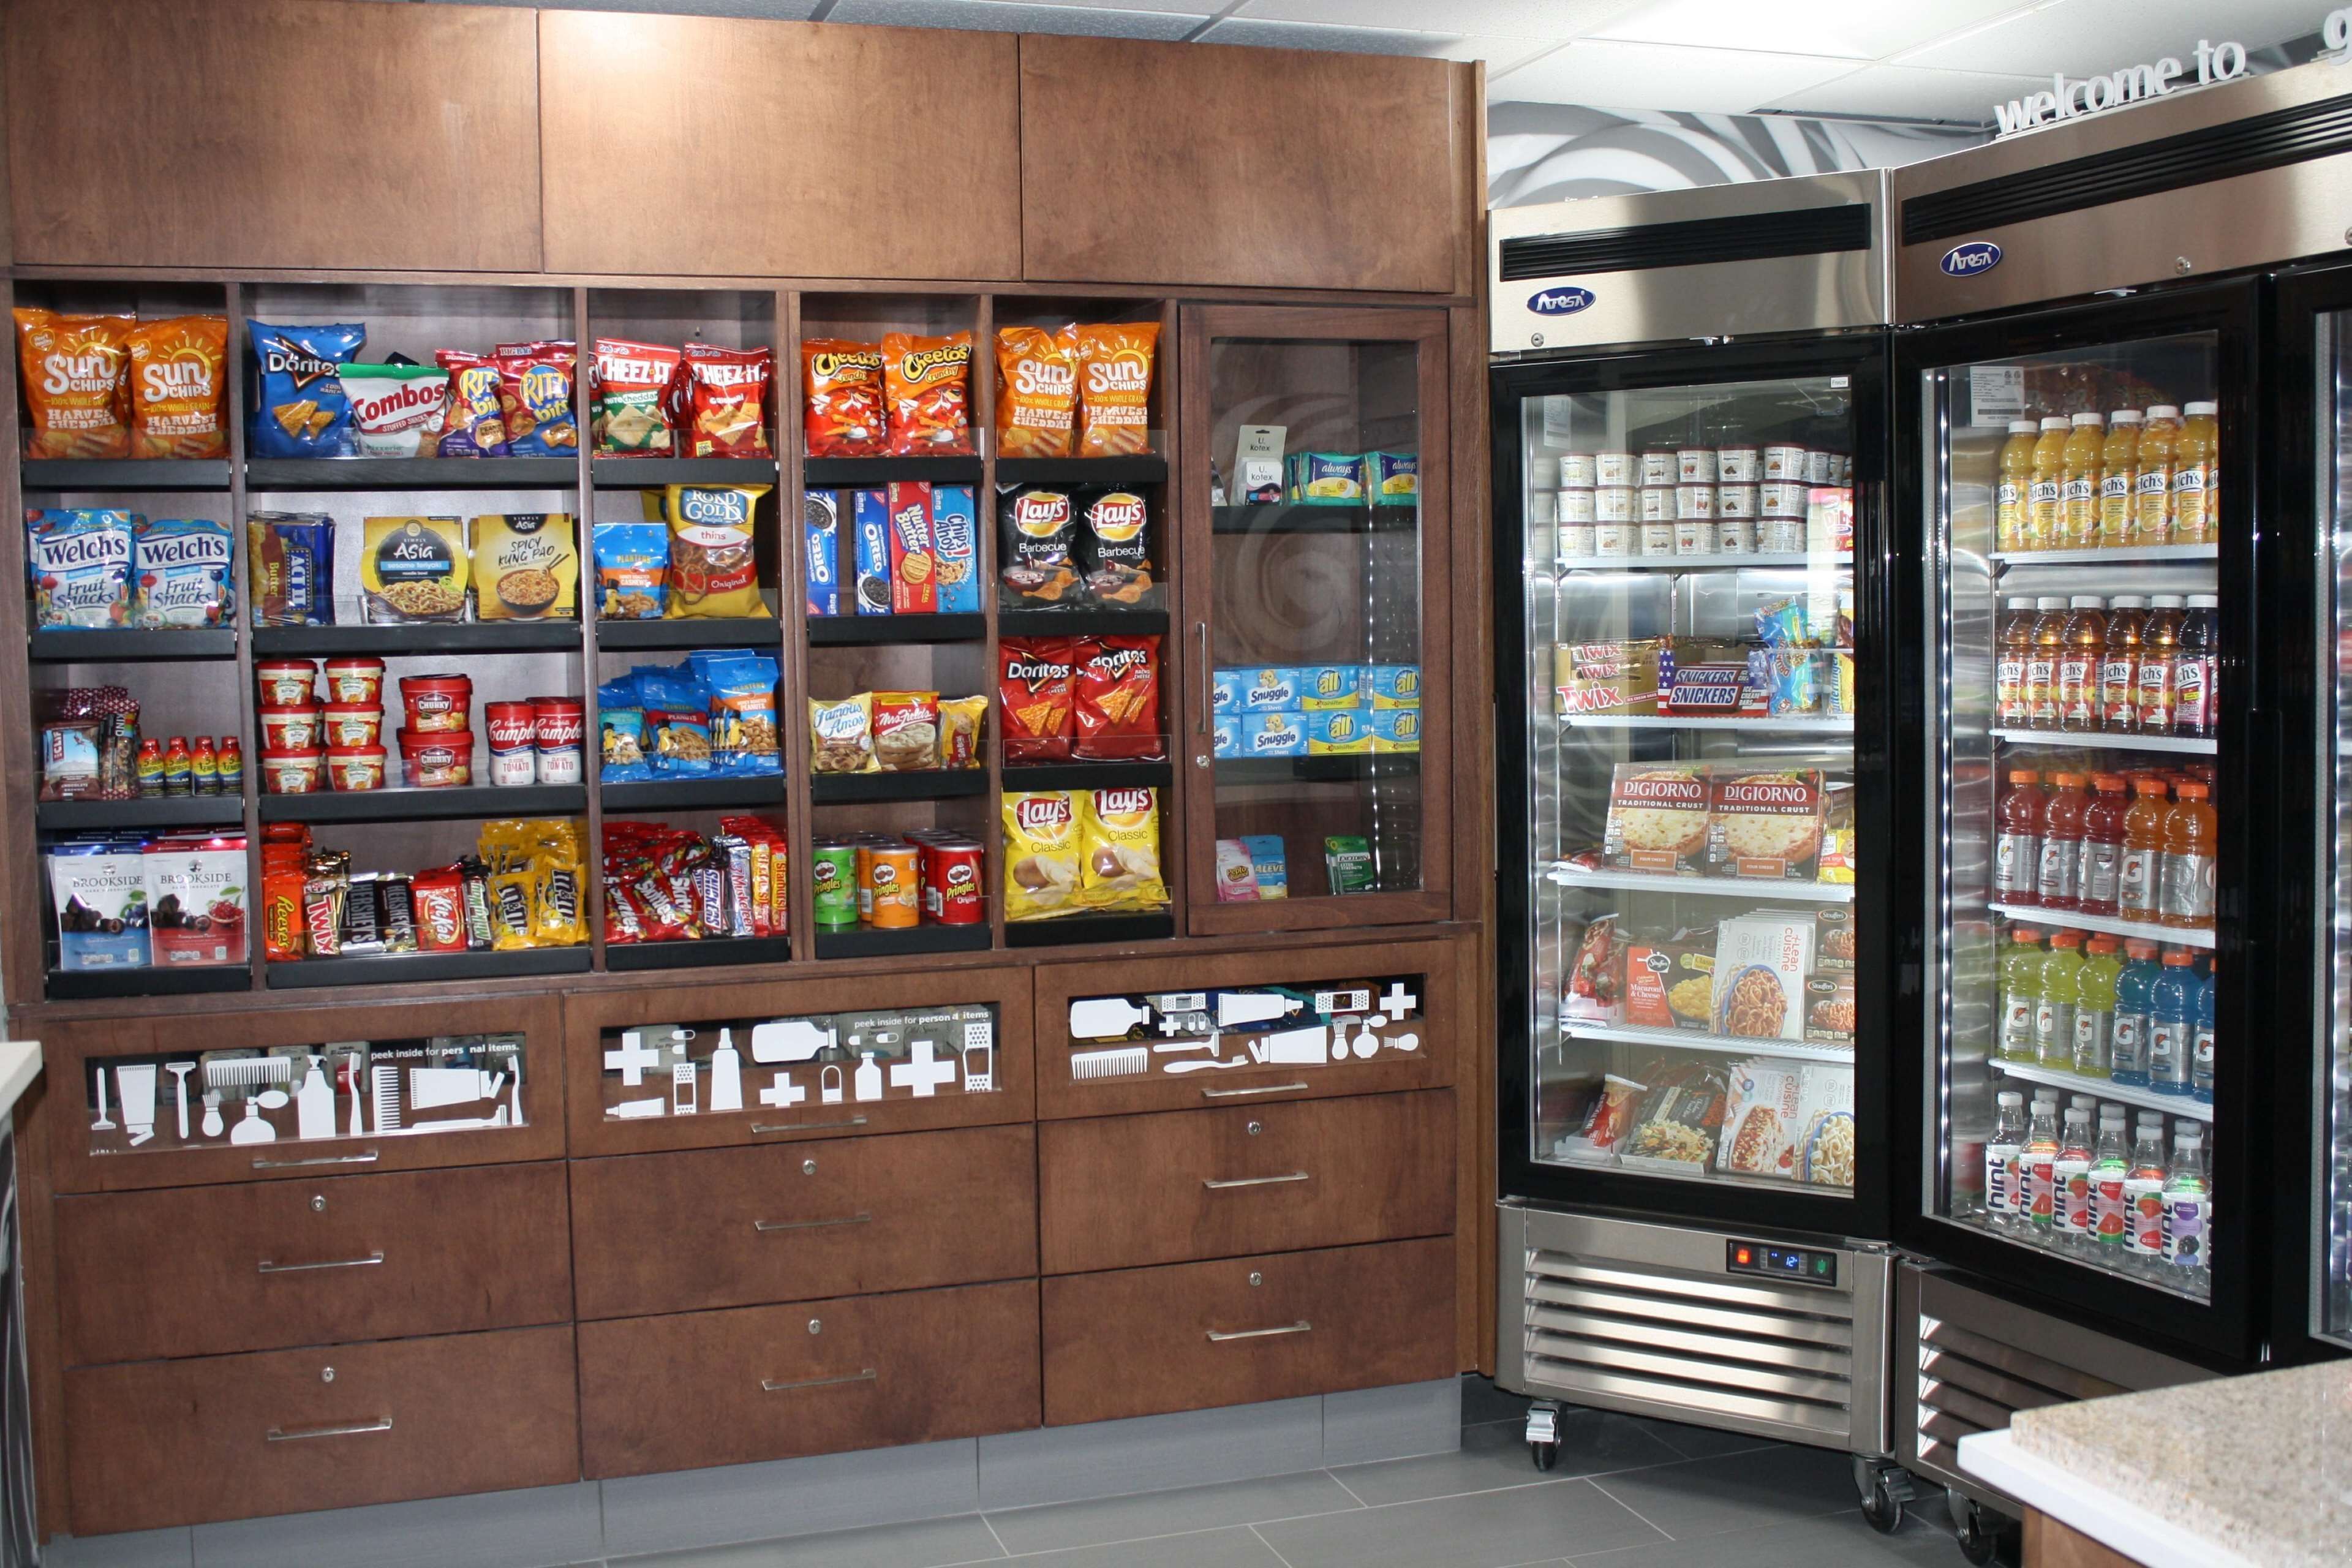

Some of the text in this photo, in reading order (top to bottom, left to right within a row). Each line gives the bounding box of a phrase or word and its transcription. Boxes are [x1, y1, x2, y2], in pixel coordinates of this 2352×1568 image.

[1994, 39, 2246, 135] welcome to
[500, 345, 532, 356] BIG BAG
[598, 345, 612, 354] Grab
[815, 352, 882, 377] Cheetos
[903, 344, 970, 382] Cheetos
[44, 354, 116, 394] Sun
[143, 360, 212, 402] Sun
[925, 366, 959, 383] Crunchy
[1015, 359, 1074, 394] Sun
[1088, 361, 1148, 393] Sun
[69, 379, 115, 392] CHIPS
[168, 385, 211, 397] CHIPS
[522, 372, 565, 407] RITZ
[1036, 382, 1072, 395] CHIPS
[1109, 379, 1147, 391] CHIPS
[353, 382, 446, 423] Combos
[622, 391, 658, 404] cheddar
[1034, 397, 1053, 406] WHOLE
[1014, 405, 1072, 421] HARVEST
[1090, 405, 1147, 416] HARVEST
[147, 414, 217, 428] HARVEST
[382, 421, 407, 432] STUFFED
[1012, 415, 1071, 429] CHEDDAR
[1089, 415, 1147, 425] CHEDDAR
[147, 423, 217, 435] CHEDDAR
[1321, 462, 1354, 474] always
[1392, 460, 1416, 471] always
[685, 502, 742, 521] GOLD
[1020, 499, 1066, 524] Lay's
[1096, 502, 1142, 529] Lay's
[514, 521, 535, 530] Asia
[895, 511, 921, 554] Butter
[907, 504, 930, 548] Nutter
[946, 514, 967, 552] Chips
[701, 531, 726, 540] thins
[44, 536, 127, 565] Welch's
[142, 537, 225, 564] Welch's
[393, 543, 434, 560] Asia
[510, 536, 542, 553] SPICY
[863, 522, 882, 572] OREO
[1019, 543, 1067, 552] Barbecue
[1098, 546, 1145, 558] Barbecue
[498, 550, 529, 567] KUNG
[531, 545, 555, 560] PAO
[812, 533, 831, 584] OREO
[417, 562, 442, 570] teriyaki
[68, 579, 106, 596] Fruit
[166, 578, 205, 595] Fruit
[269, 562, 280, 598] Butter
[711, 575, 747, 589] Original
[56, 592, 115, 609] Snacks
[153, 592, 213, 610] Snacks
[1089, 649, 1147, 669] Doritos
[1008, 662, 1070, 679] Doritos
[1677, 670, 1736, 683] SNICKERS
[1318, 671, 1340, 695] all
[1395, 671, 1419, 695] all
[1251, 687, 1289, 704] Snuggle
[1672, 686, 1736, 704] SNICKERS
[418, 700, 450, 710] CHUNKY
[814, 703, 862, 729] Famous
[901, 707, 933, 725] Fields
[115, 713, 127, 737] KIND
[826, 715, 866, 737] Amos
[1330, 715, 1352, 738] all
[1395, 715, 1419, 738] all
[1257, 733, 1295, 748] Snuggle
[421, 754, 452, 764] CHUNKY
[502, 762, 530, 772] TOMATO
[547, 761, 573, 771] TOMATO
[1100, 788, 1148, 816] Lay's
[1617, 799, 1673, 808] TRADITIONAL
[1719, 804, 1778, 813] TRADITIONAL
[1022, 799, 1069, 828] Lay's
[1107, 829, 1148, 842] Classic
[1031, 840, 1071, 853] Classic
[1255, 864, 1284, 873] ALEVE
[73, 876, 143, 888] BROOKSIDE
[160, 873, 232, 884] BROOKSIDE
[814, 879, 842, 894] Pringles
[705, 869, 720, 928] SNICKERS
[873, 883, 899, 899] Pringles
[946, 881, 975, 901] Pringles
[351, 884, 377, 943] HERSHEY'S
[386, 885, 412, 935] HERSHEY'S
[277, 895, 295, 949] Reese's
[1781, 927, 1793, 972] cuisine
[1789, 943, 1800, 972] Lean
[1630, 984, 1662, 993] Macaroni
[854, 1020, 875, 1029] peek
[877, 1016, 902, 1027] inside
[904, 1016, 917, 1024] for
[371, 1042, 520, 1061] peek inside for items.
[1781, 1075, 1794, 1119] cuisine
[1789, 1093, 1800, 1120] Lean
[1988, 1157, 2005, 1209] hint
[2051, 1175, 2067, 1229] hint
[2123, 1193, 2135, 1248] hint
